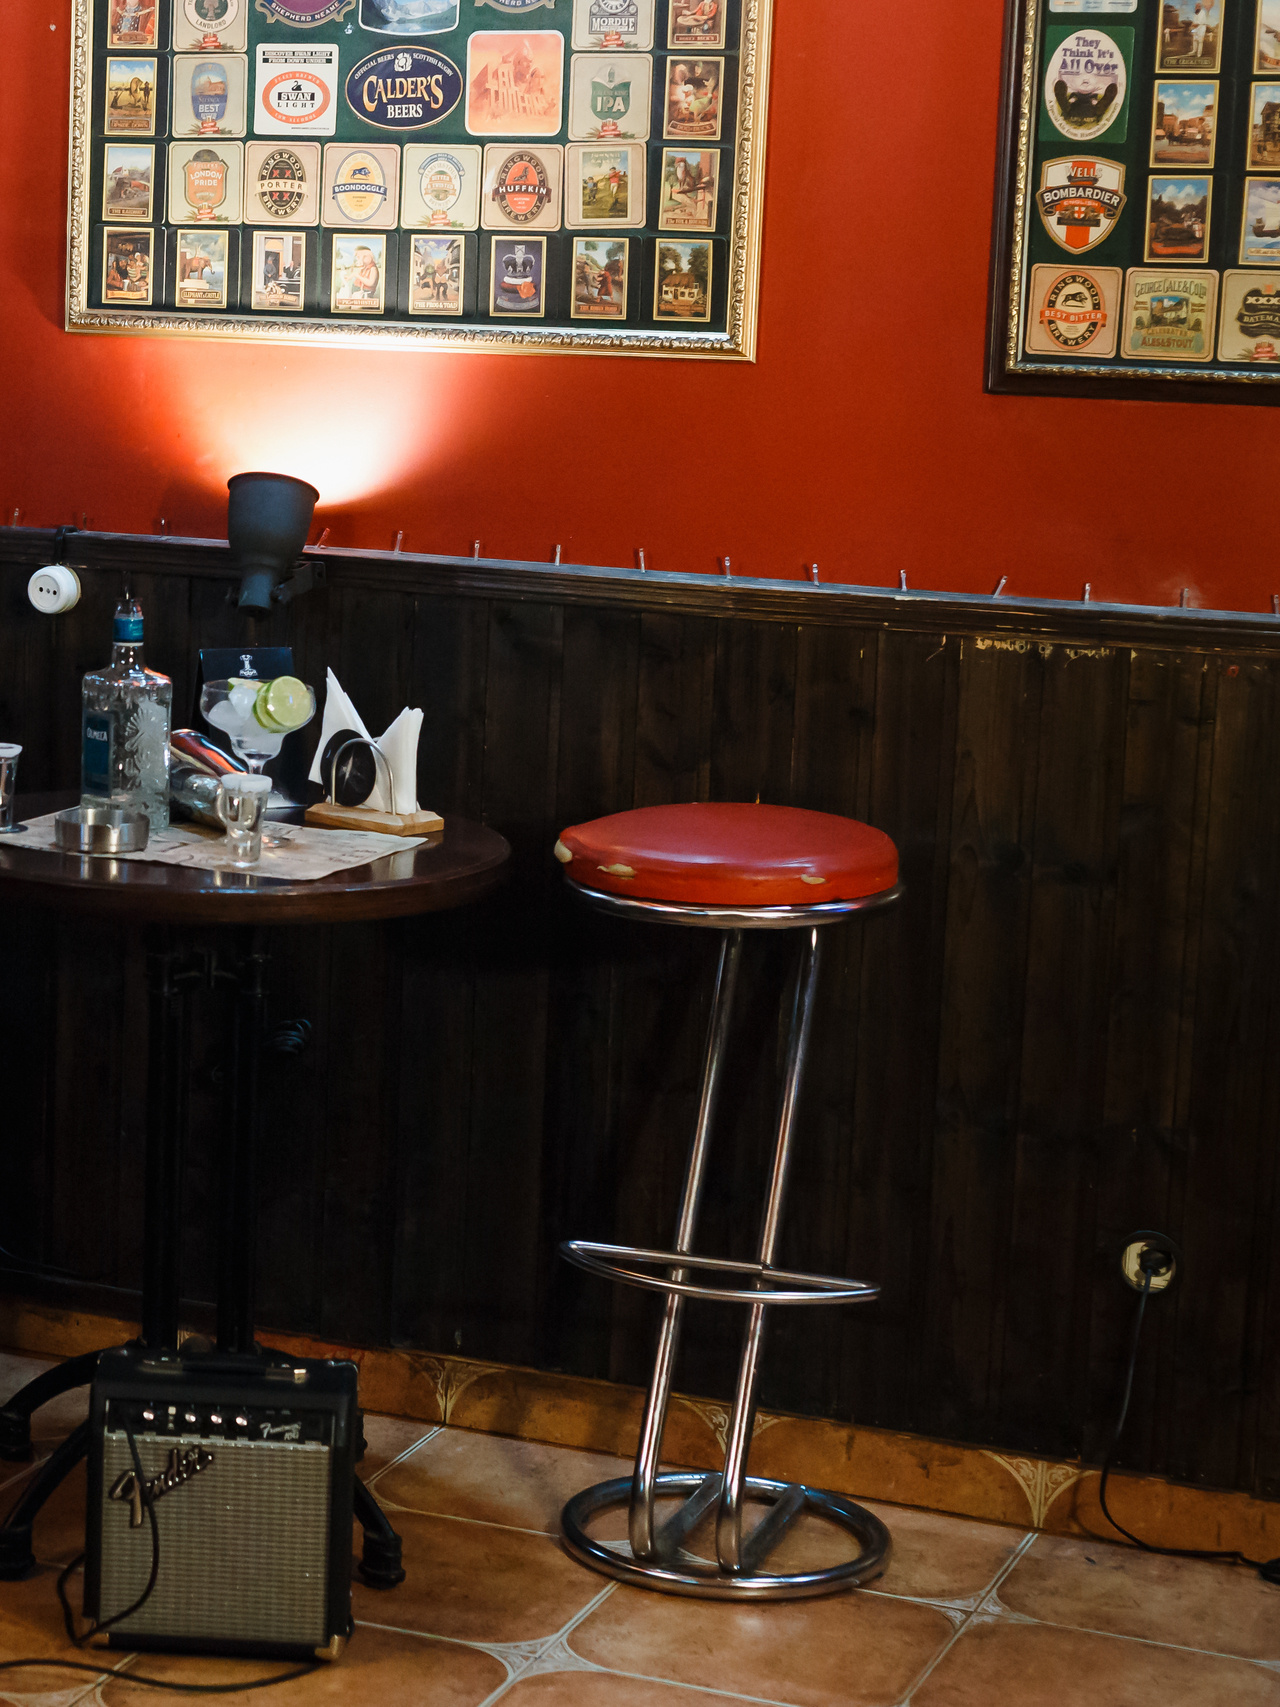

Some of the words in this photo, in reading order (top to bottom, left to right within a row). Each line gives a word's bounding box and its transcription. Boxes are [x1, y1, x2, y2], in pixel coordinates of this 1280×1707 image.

[271, 2, 312, 22] SHEPHERD
[314, 1, 340, 20] NEAME
[195, 19, 228, 30] LANDLORD
[592, 17, 635, 31] MORDUE
[1075, 36, 1101, 49] They
[1062, 48, 1094, 58] Think
[1097, 49, 1114, 59] It's
[354, 60, 377, 80] OFFICIAL
[377, 54, 395, 64] BEERS
[412, 53, 439, 66] SCOTTISH
[437, 60, 454, 77] RUGBY
[1060, 58, 1081, 70] All
[1084, 59, 1118, 74] Over
[281, 93, 312, 101] SWAN
[363, 75, 444, 112] CALDER'S
[199, 104, 220, 113] BEST
[386, 103, 423, 118] BEERS
[596, 96, 626, 112] IPA
[262, 152, 303, 177] RINGWOOD
[501, 154, 544, 180] RINGWOOD
[1065, 165, 1103, 179] WELLS
[189, 170, 223, 180] LONDON
[260, 181, 303, 190] PORTER
[334, 184, 386, 194] BOONDOGGLE
[499, 185, 547, 195] HUFFKIN
[1043, 187, 1120, 207] BOMBARDIER
[262, 195, 300, 215] BREWERY
[501, 200, 541, 220] BREWERY
[183, 291, 204, 299] ELEPHANT
[1049, 276, 1100, 303] RINGWOOD
[1135, 281, 1163, 298] GEORGE
[1245, 296, 1280, 304] XXX
[1045, 310, 1068, 320] BEST
[1069, 312, 1103, 322] BITTER
[1049, 322, 1095, 346] BREWERY
[86, 727, 109, 742] OLMECA
